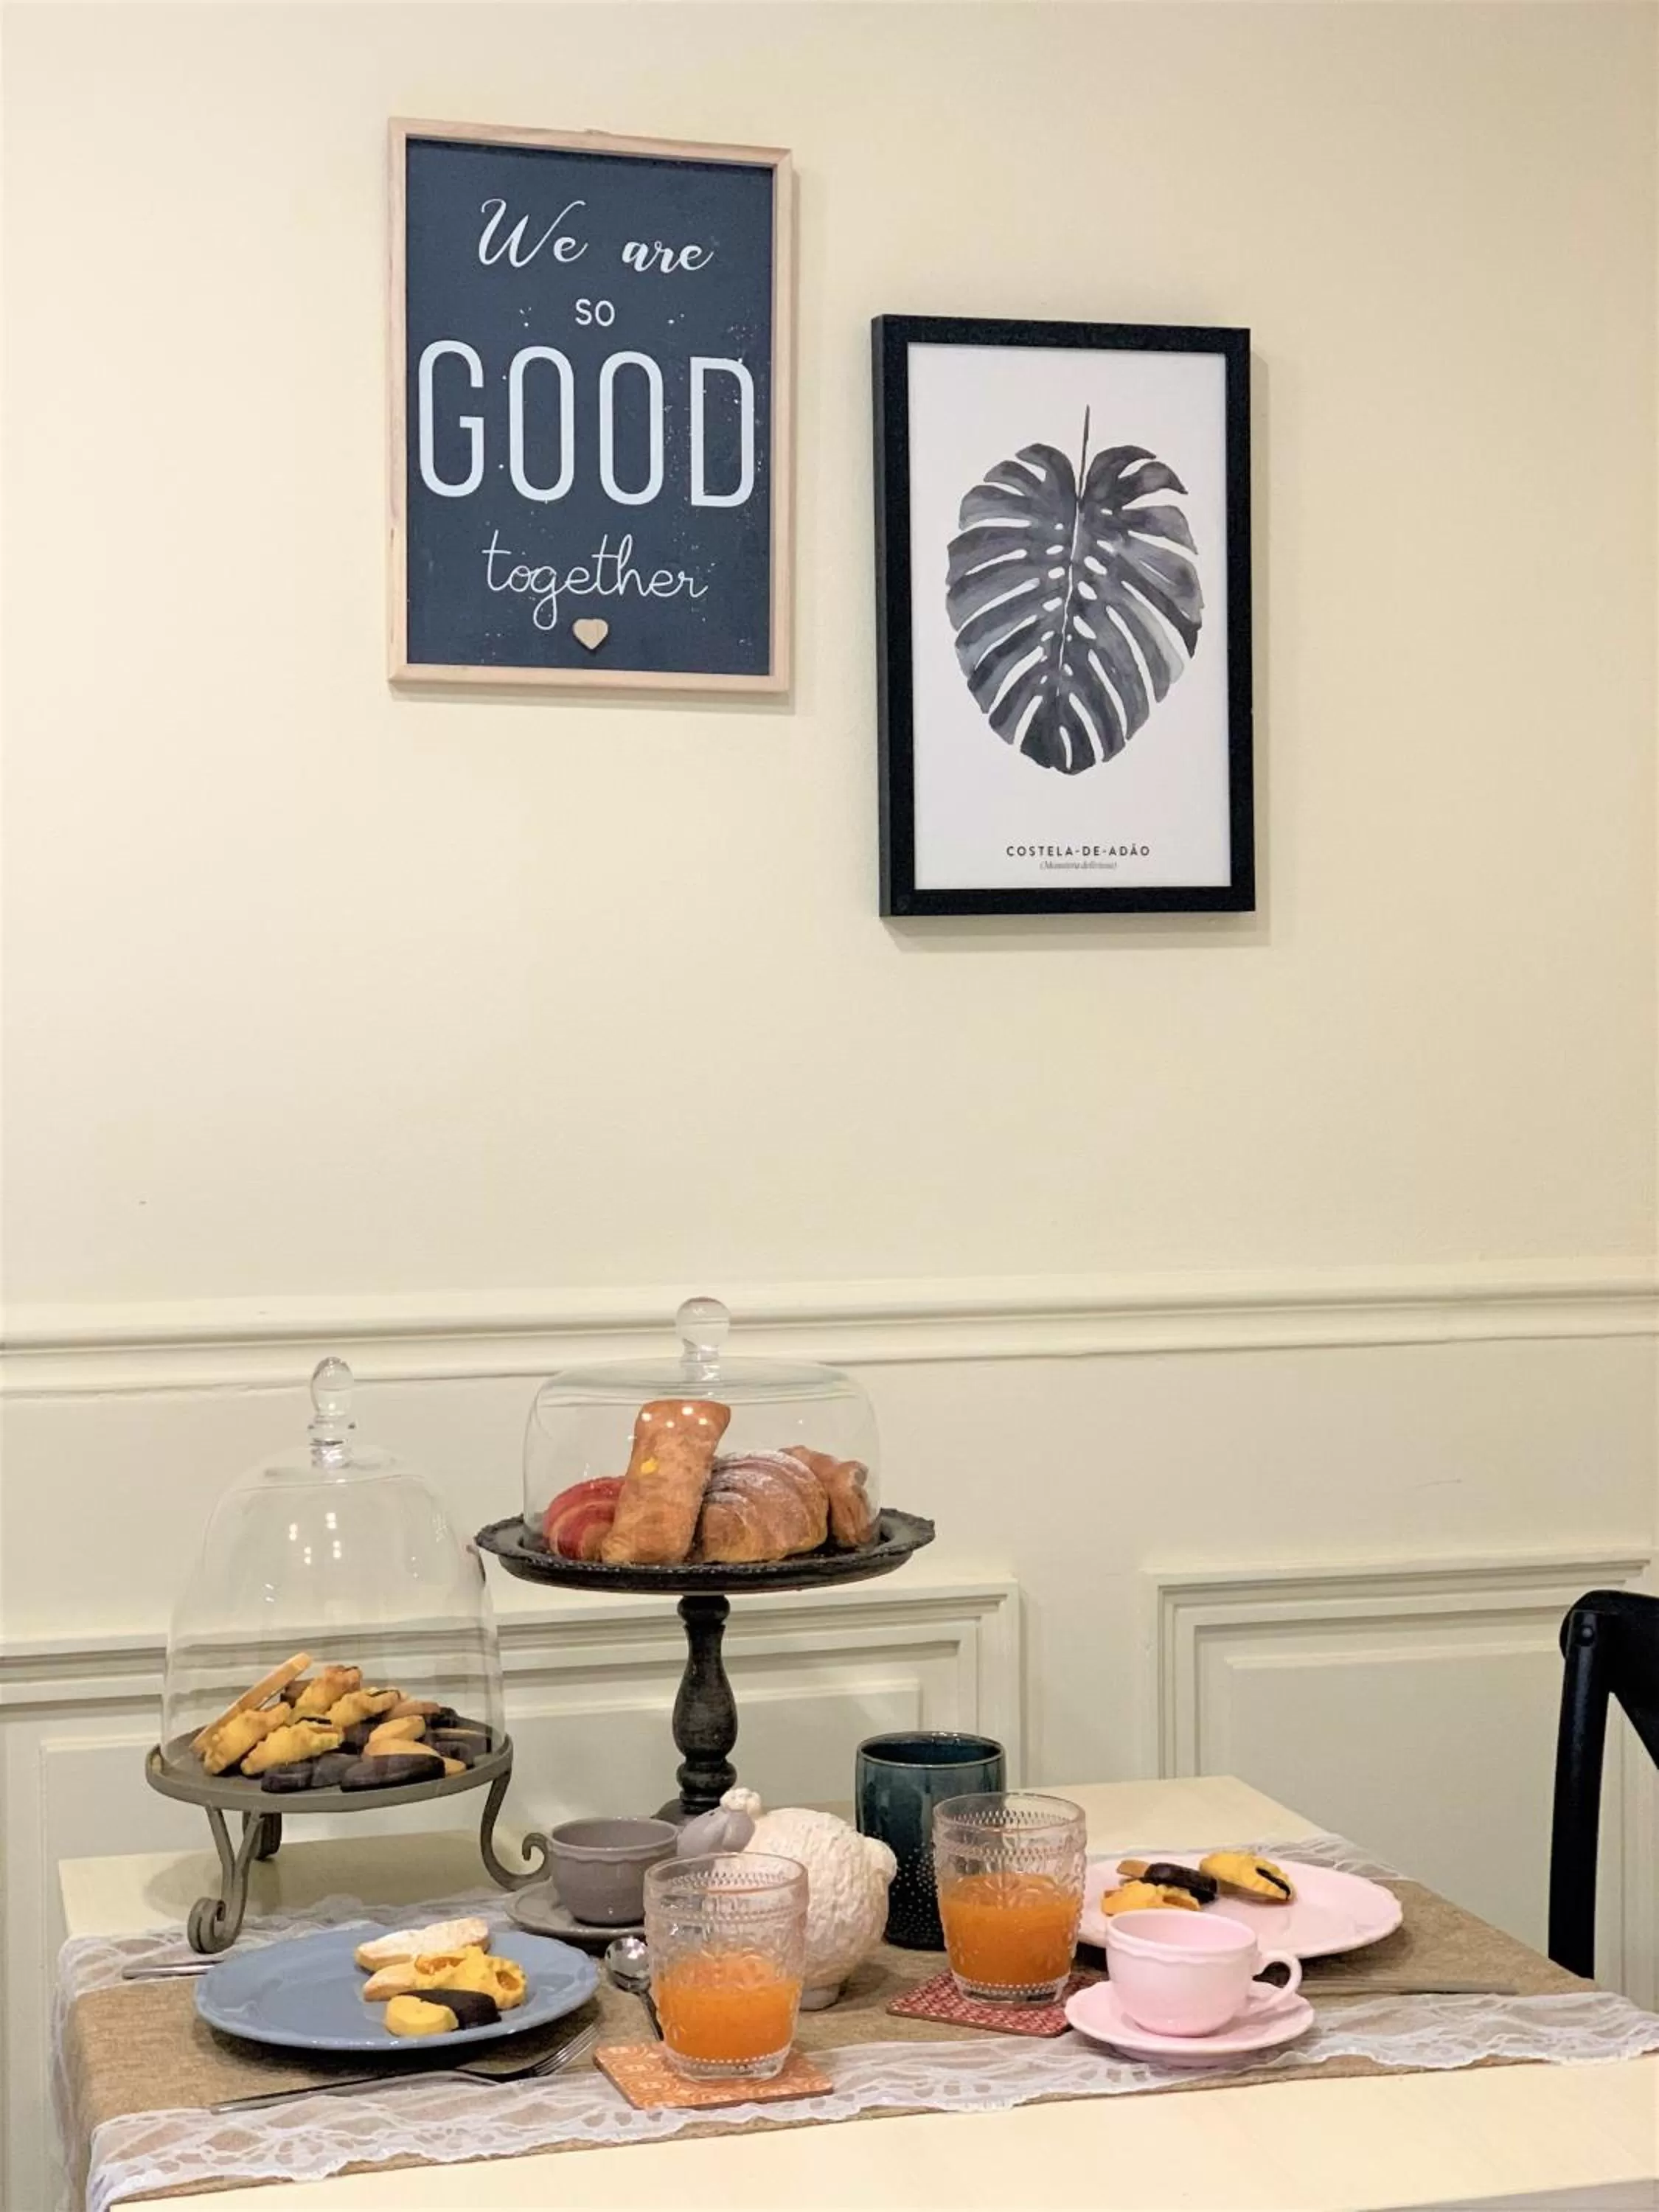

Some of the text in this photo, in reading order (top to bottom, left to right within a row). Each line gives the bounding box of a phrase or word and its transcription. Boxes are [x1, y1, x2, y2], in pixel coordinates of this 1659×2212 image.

[478, 198, 714, 273] We are
[575, 299, 616, 327] SO
[418, 340, 755, 507] GOOD
[481, 529, 709, 630] together
[1006, 843, 1150, 857] COSTELA-DE-ADÃO
